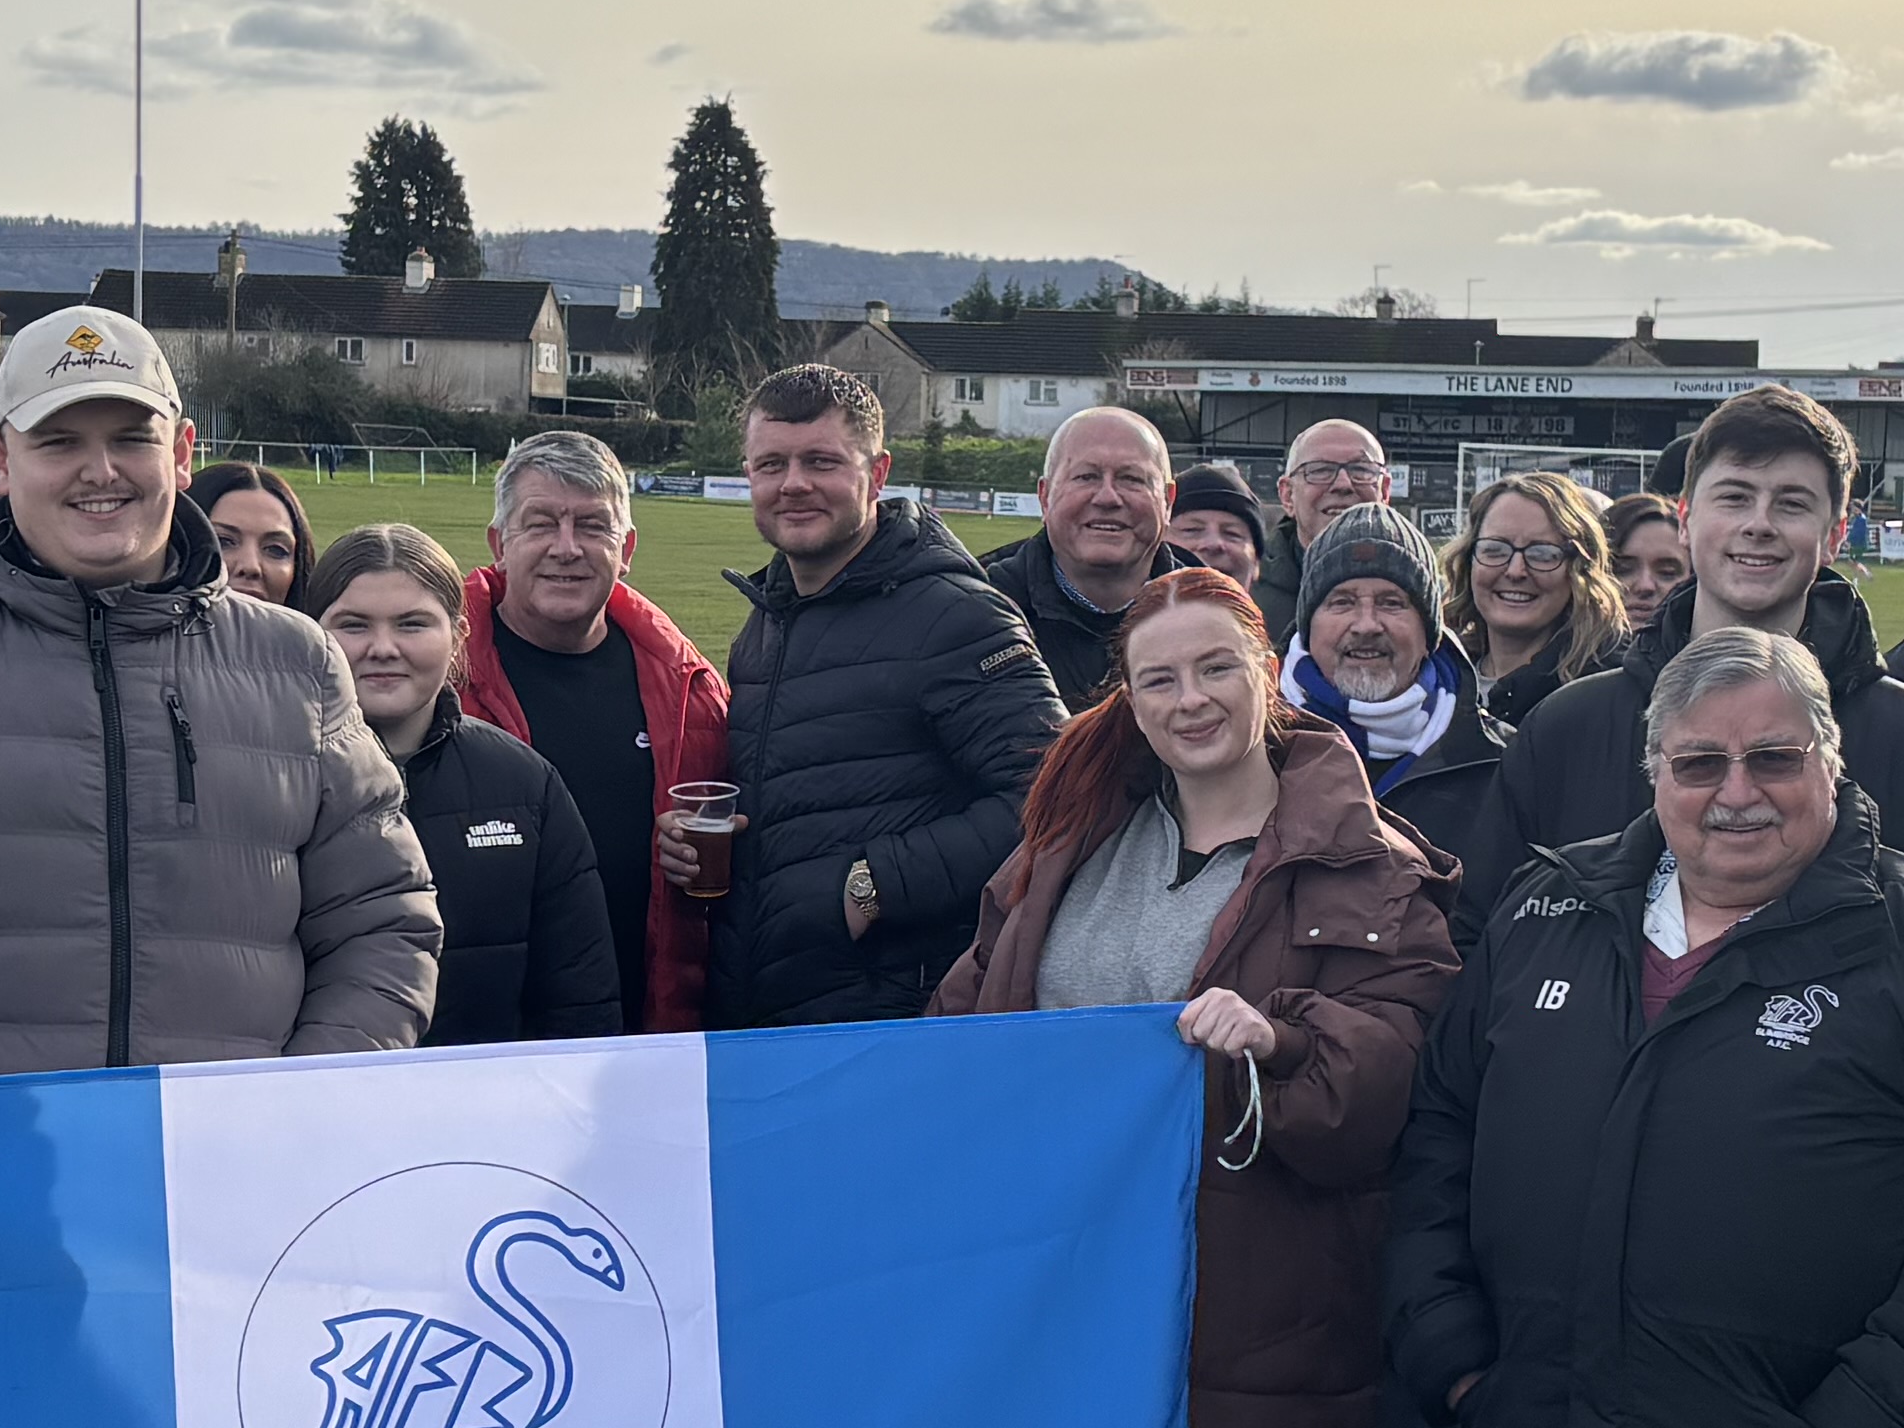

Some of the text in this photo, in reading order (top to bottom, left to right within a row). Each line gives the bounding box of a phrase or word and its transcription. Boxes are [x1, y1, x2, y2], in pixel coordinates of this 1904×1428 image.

[46, 350, 134, 378] Australia
[1273, 375, 1347, 387] Founded 1898
[1446, 376, 1573, 394] THE LANE END
[1673, 380, 1723, 393] Founded
[1393, 417, 1461, 430] ST FC
[1487, 417, 1566, 432] 18 98
[468, 820, 516, 836] unlike
[465, 833, 524, 848] humans
[1534, 979, 1571, 1010] IB
